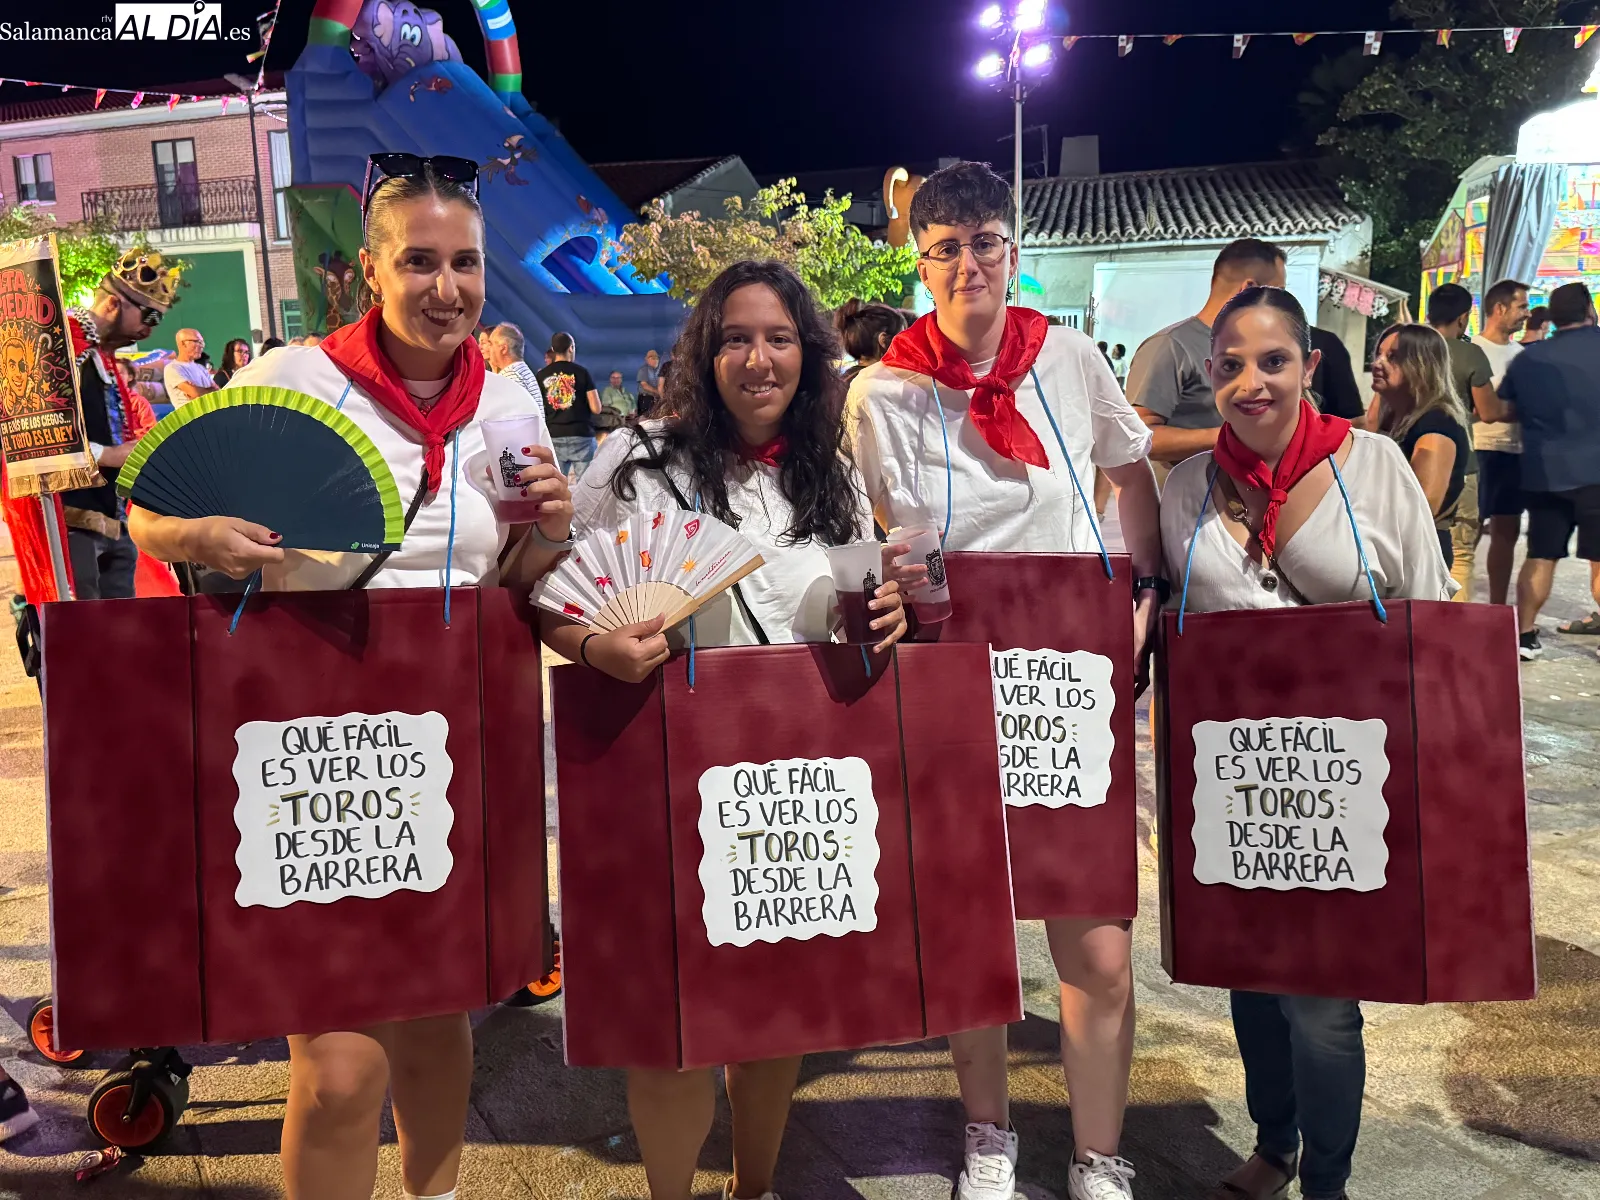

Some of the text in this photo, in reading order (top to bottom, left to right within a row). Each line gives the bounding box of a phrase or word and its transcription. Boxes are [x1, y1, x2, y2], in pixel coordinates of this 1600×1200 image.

[0, 270, 27, 294] ETA
[20, 418, 30, 431] DE
[30, 416, 40, 429] LOS
[32, 429, 45, 446] ES
[43, 428, 55, 445] EL
[53, 425, 73, 443] REY
[992, 653, 1082, 682] UÉ FÁCIL
[1000, 684, 1096, 710] VER LOS
[282, 718, 412, 756] QUÉ FÁCIL
[997, 711, 1066, 743] OROS
[1229, 722, 1345, 753] QUÉ FÁCIL
[261, 751, 426, 788] ES VER LOS
[1000, 744, 1081, 769] SDE LA
[1215, 755, 1362, 785] ES VER LOS
[733, 761, 846, 798] QUÉ FÁCIL
[1003, 772, 1082, 798] RRERA
[280, 786, 404, 826] TOROS
[718, 798, 858, 829] ES VER LOS
[1234, 784, 1334, 819] TOROS
[275, 820, 416, 860] DESDE LA
[737, 829, 840, 864] TOROS
[1226, 821, 1348, 852] DESDE LA
[279, 852, 423, 895] BARRERA
[729, 862, 853, 896] DESDE LA
[1232, 851, 1355, 882] BARRERA
[733, 893, 857, 931] BARRERA
